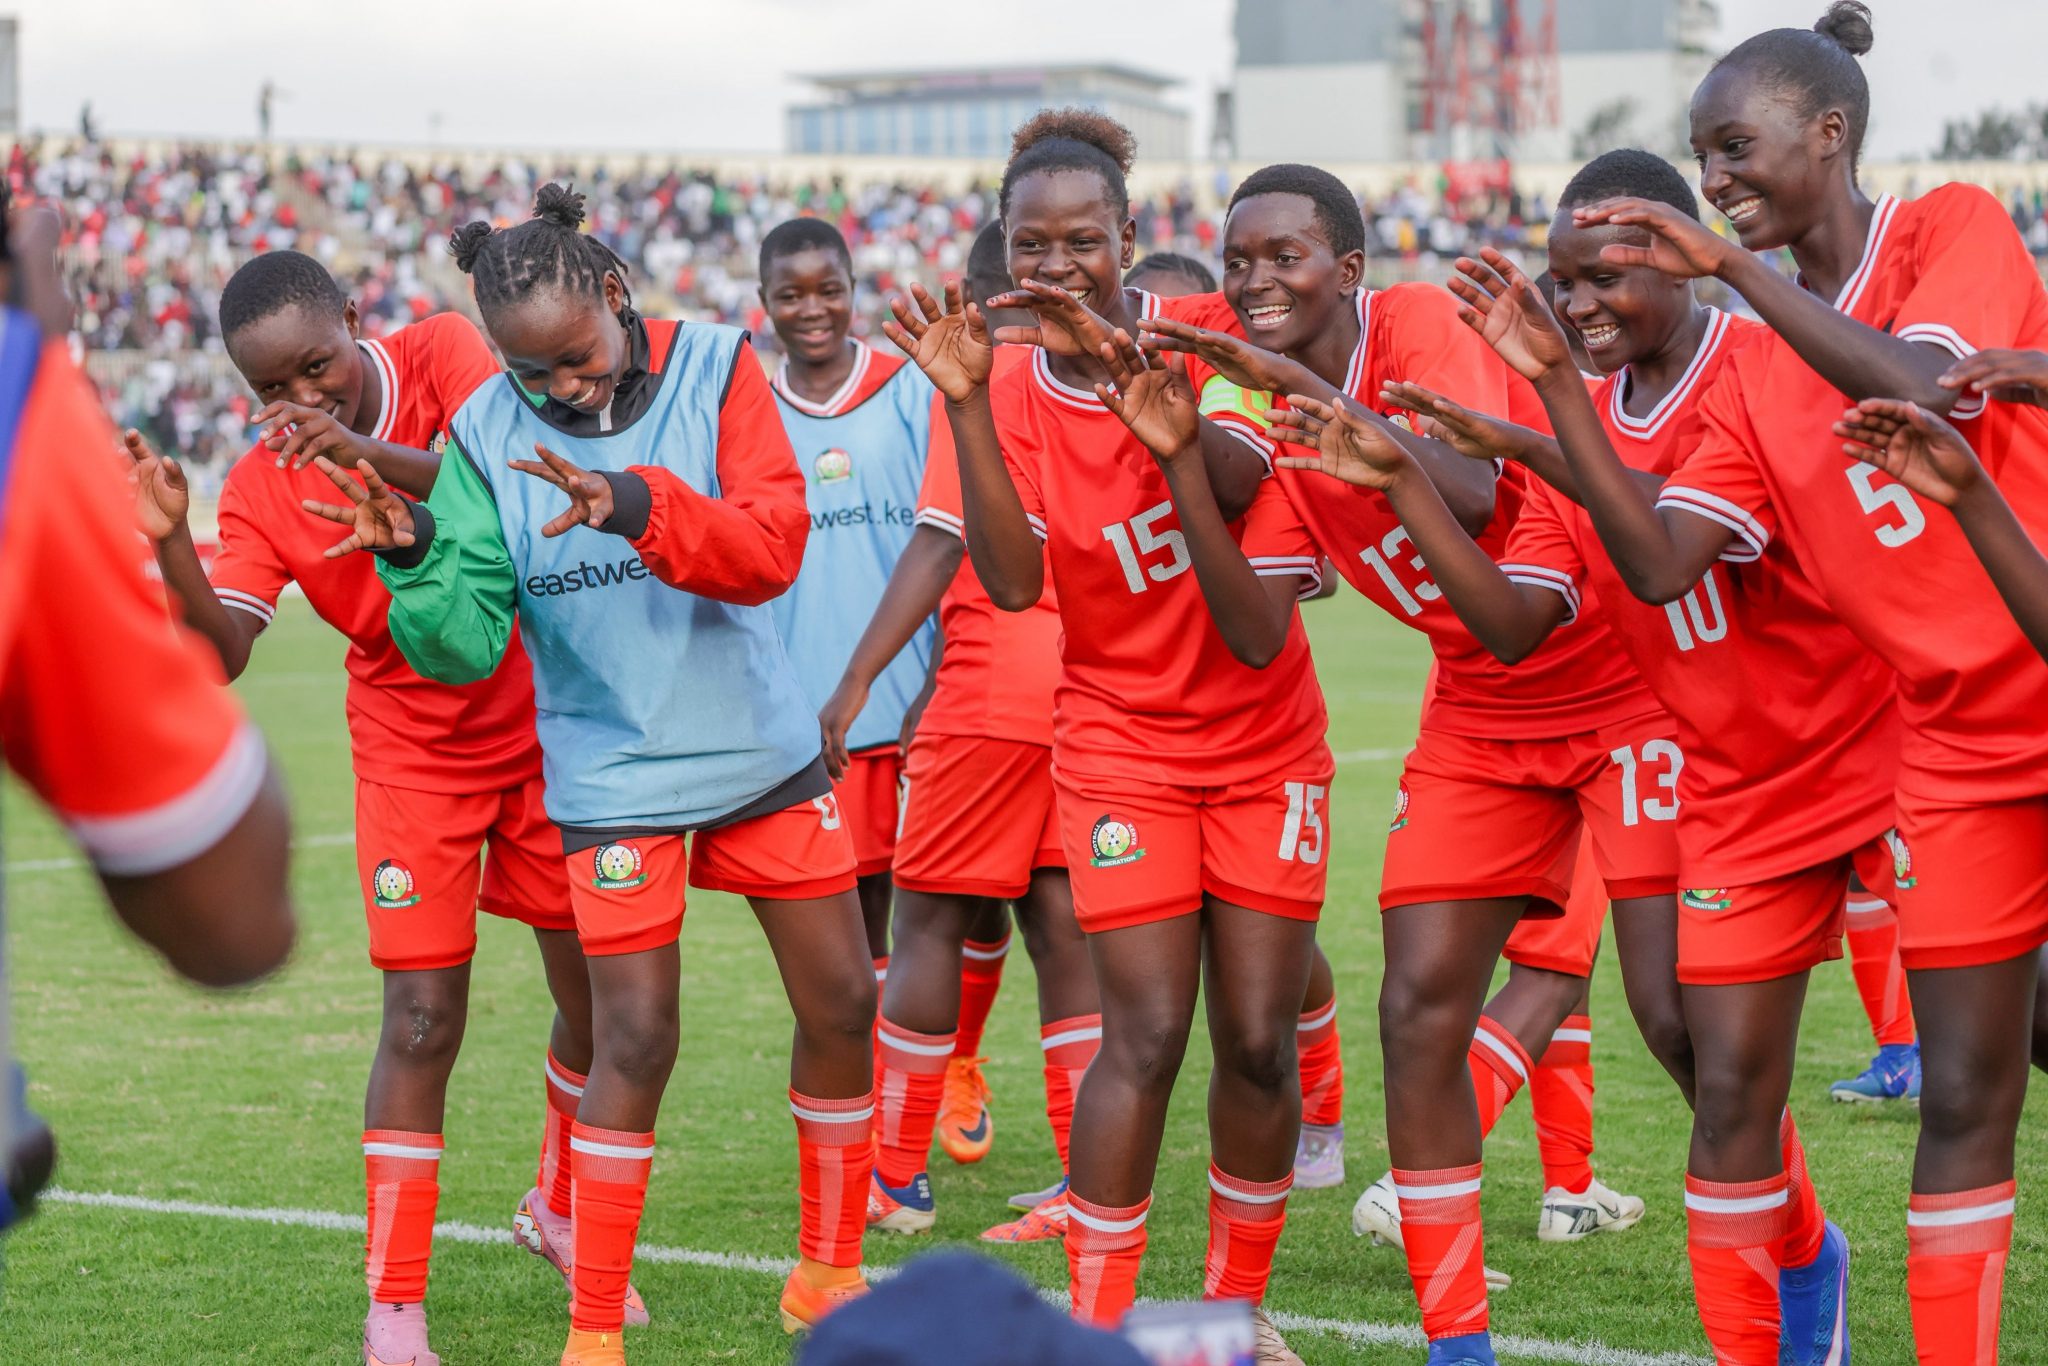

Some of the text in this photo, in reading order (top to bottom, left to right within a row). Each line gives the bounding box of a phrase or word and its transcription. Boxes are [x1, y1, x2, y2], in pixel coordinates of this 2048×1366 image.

[810, 499, 914, 531] west.ke
[1845, 460, 1926, 548] 5
[526, 557, 654, 597] eastwe
[1101, 499, 1192, 594] 15
[1663, 568, 1728, 651] 10
[1610, 739, 1685, 827] 13
[1278, 781, 1325, 865] 15
[600, 879, 640, 889] FEDERATION
[1098, 855, 1137, 868] FEDERATION
[1684, 898, 1721, 910] FEDERATION
